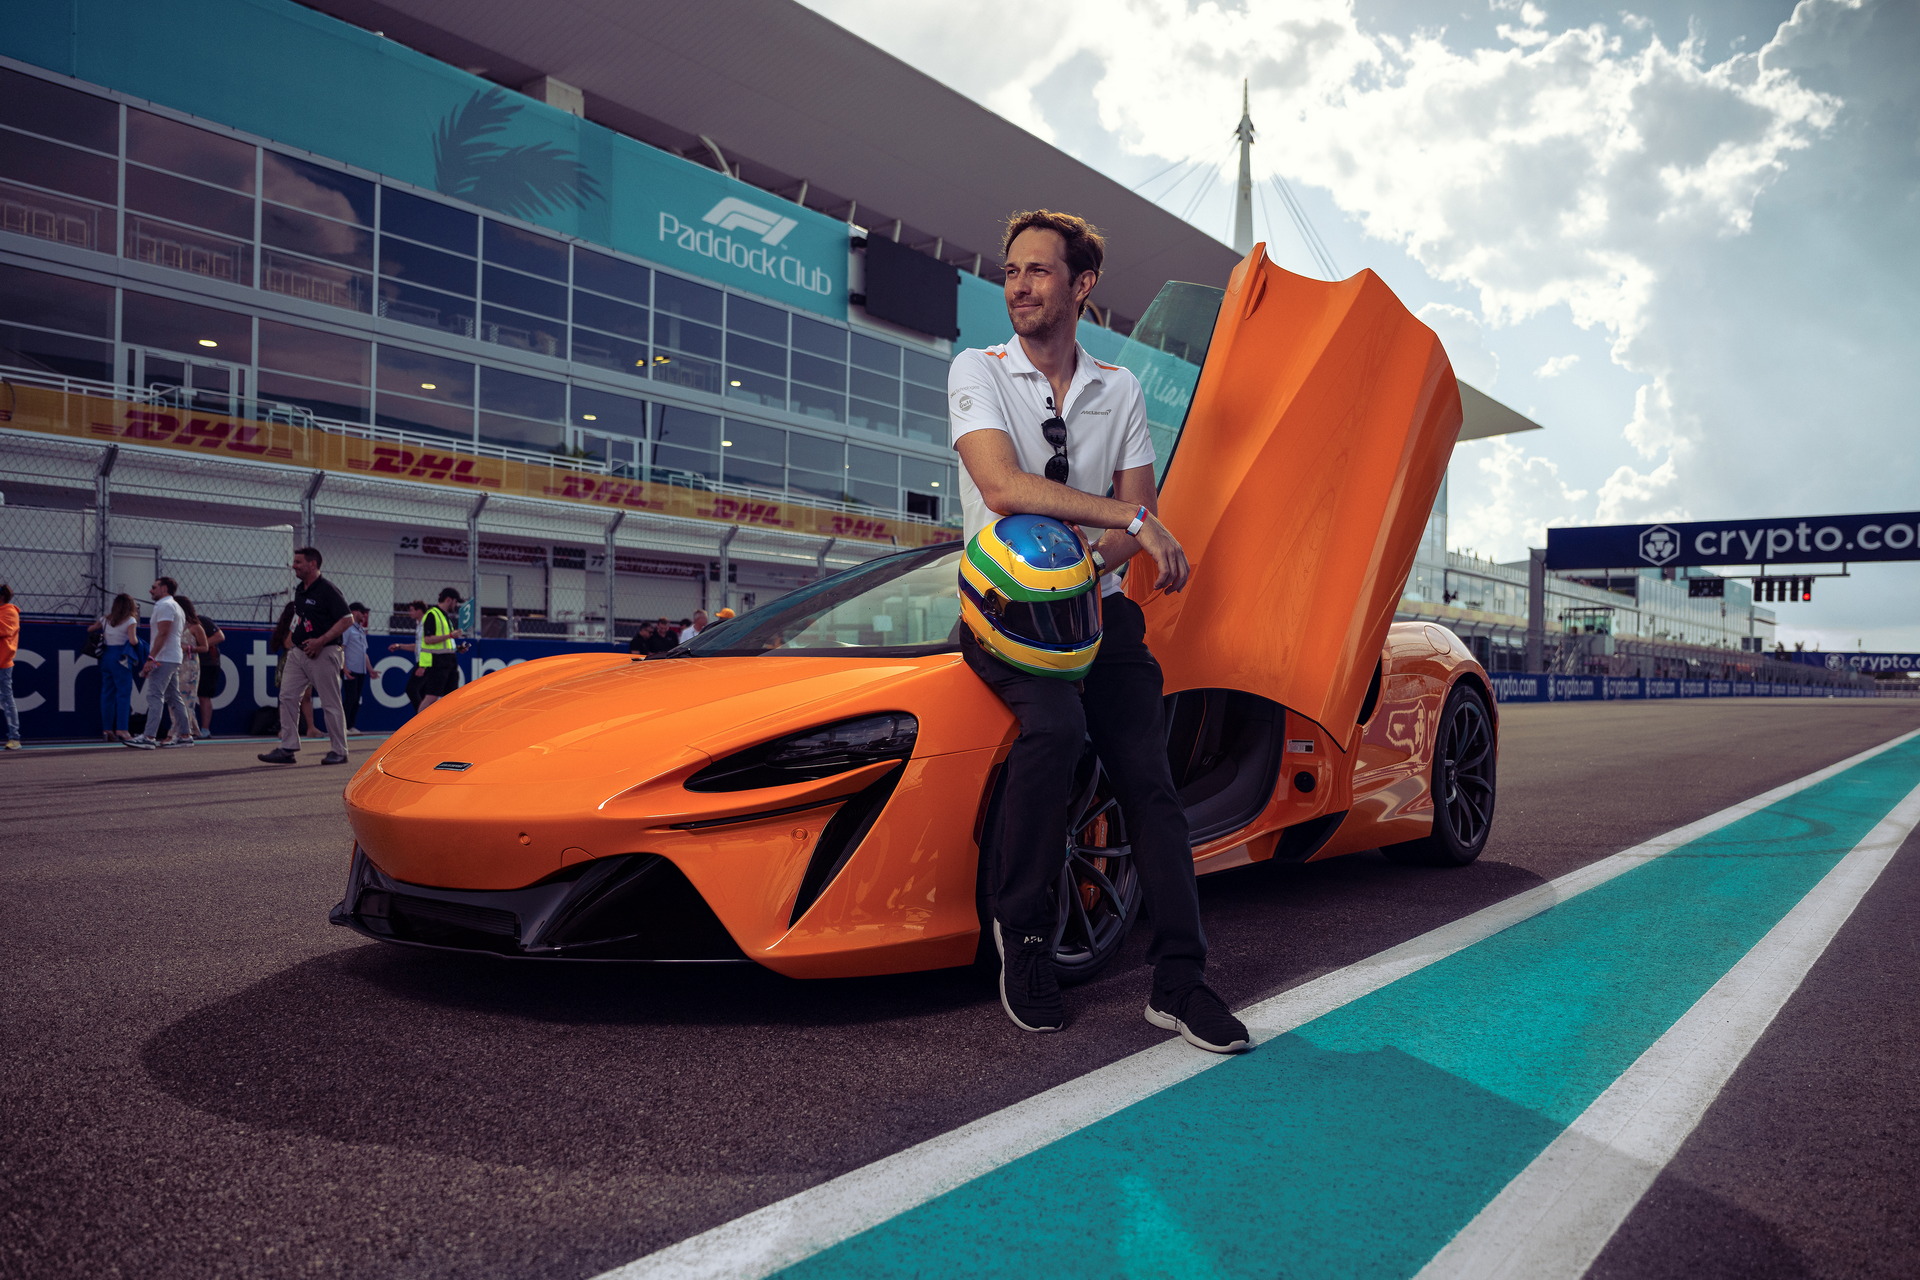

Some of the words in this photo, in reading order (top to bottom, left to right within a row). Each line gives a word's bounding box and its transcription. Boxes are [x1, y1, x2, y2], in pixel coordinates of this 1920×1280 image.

[659, 211, 777, 279] Paddock
[780, 255, 832, 296] Club
[121, 409, 269, 455] DHL
[369, 447, 482, 485] DHL
[561, 475, 648, 508] DHL
[711, 497, 783, 527] DHL
[830, 515, 893, 541] DHL
[1694, 521, 1920, 560] crypto.co
[463, 603, 471, 624] 3
[1556, 676, 1594, 699] crypto.com
